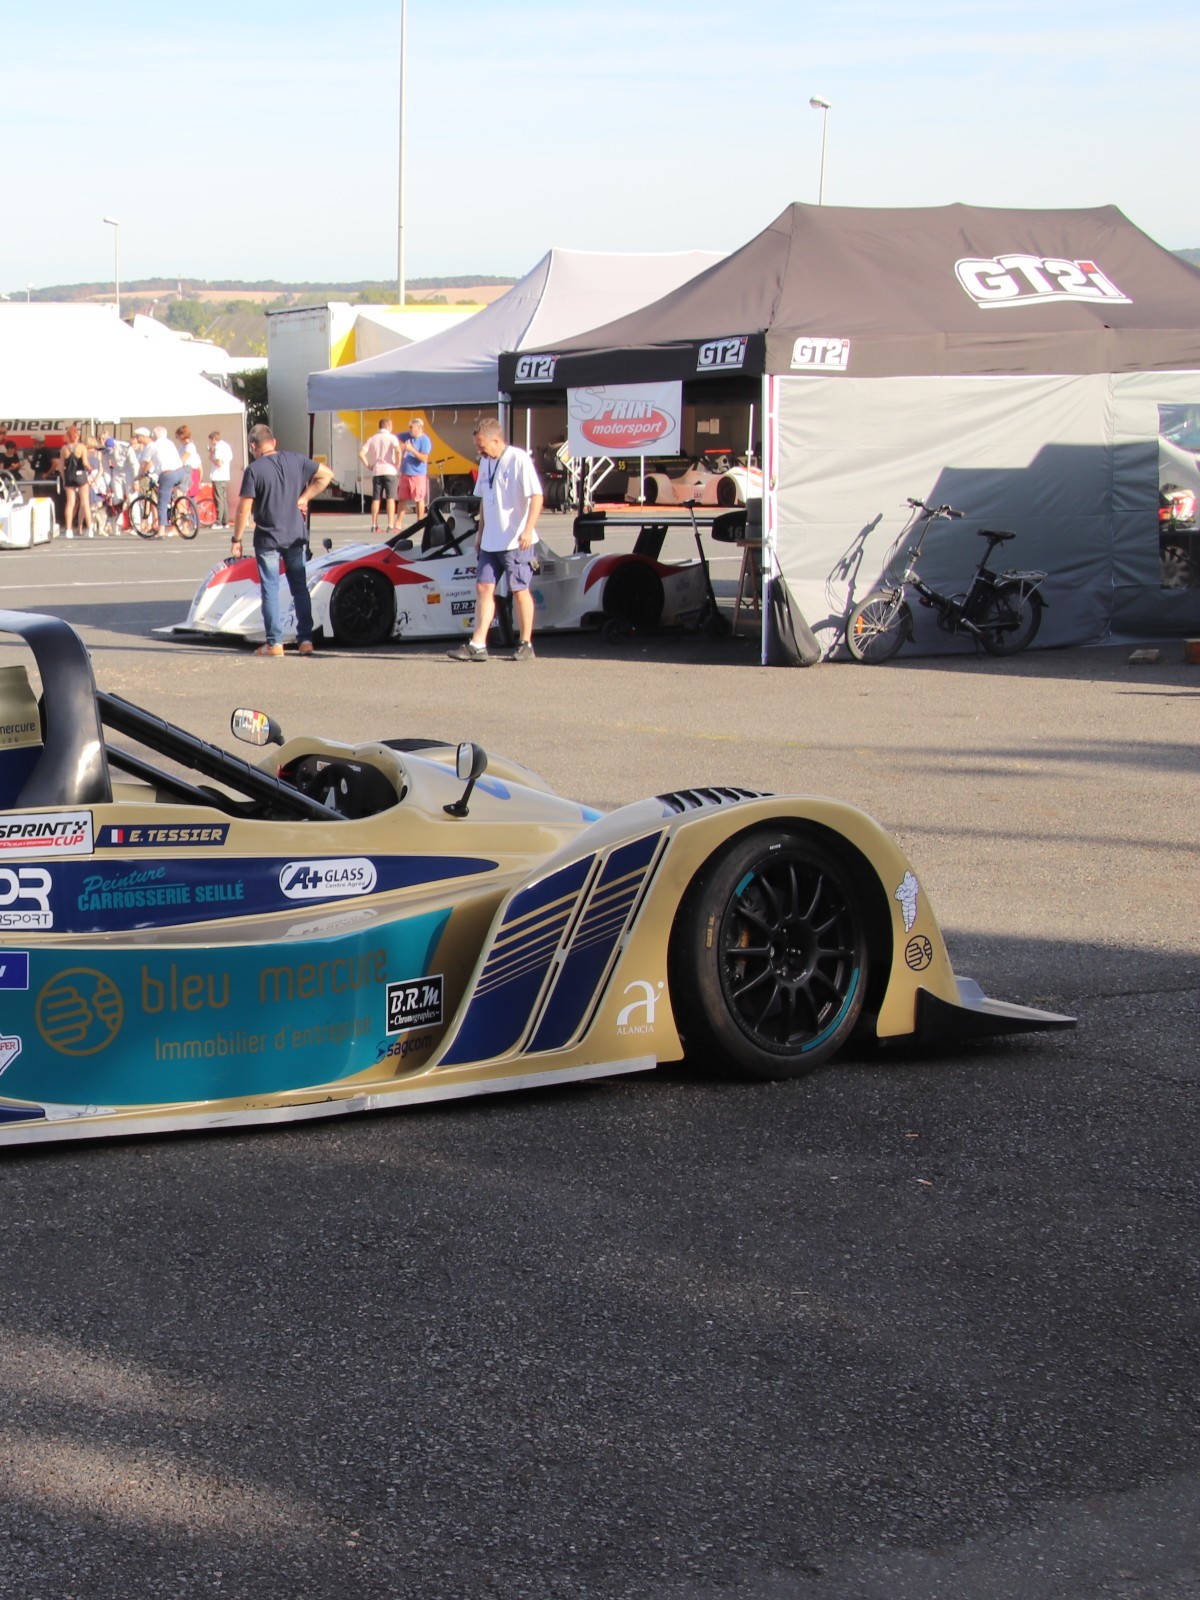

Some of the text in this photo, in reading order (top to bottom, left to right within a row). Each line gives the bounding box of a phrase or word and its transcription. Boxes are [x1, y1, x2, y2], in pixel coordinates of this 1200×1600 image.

[956, 255, 1126, 301] GT2i
[699, 337, 748, 366] GT2i
[794, 338, 849, 366] GT2i
[516, 355, 558, 379] GT2i
[592, 421, 662, 436] motorsport
[54, 835, 84, 846] CUP
[129, 829, 223, 842] E. TESSIER
[83, 867, 166, 895] Peinture
[324, 867, 364, 882] GLASS
[78, 880, 244, 911] CARROSSERIE SEILLÉ
[141, 949, 388, 1014] bleu mercure
[616, 1025, 655, 1035] ALANCIA
[155, 1031, 267, 1061] Immobilier
[386, 1035, 432, 1058] sagcom
